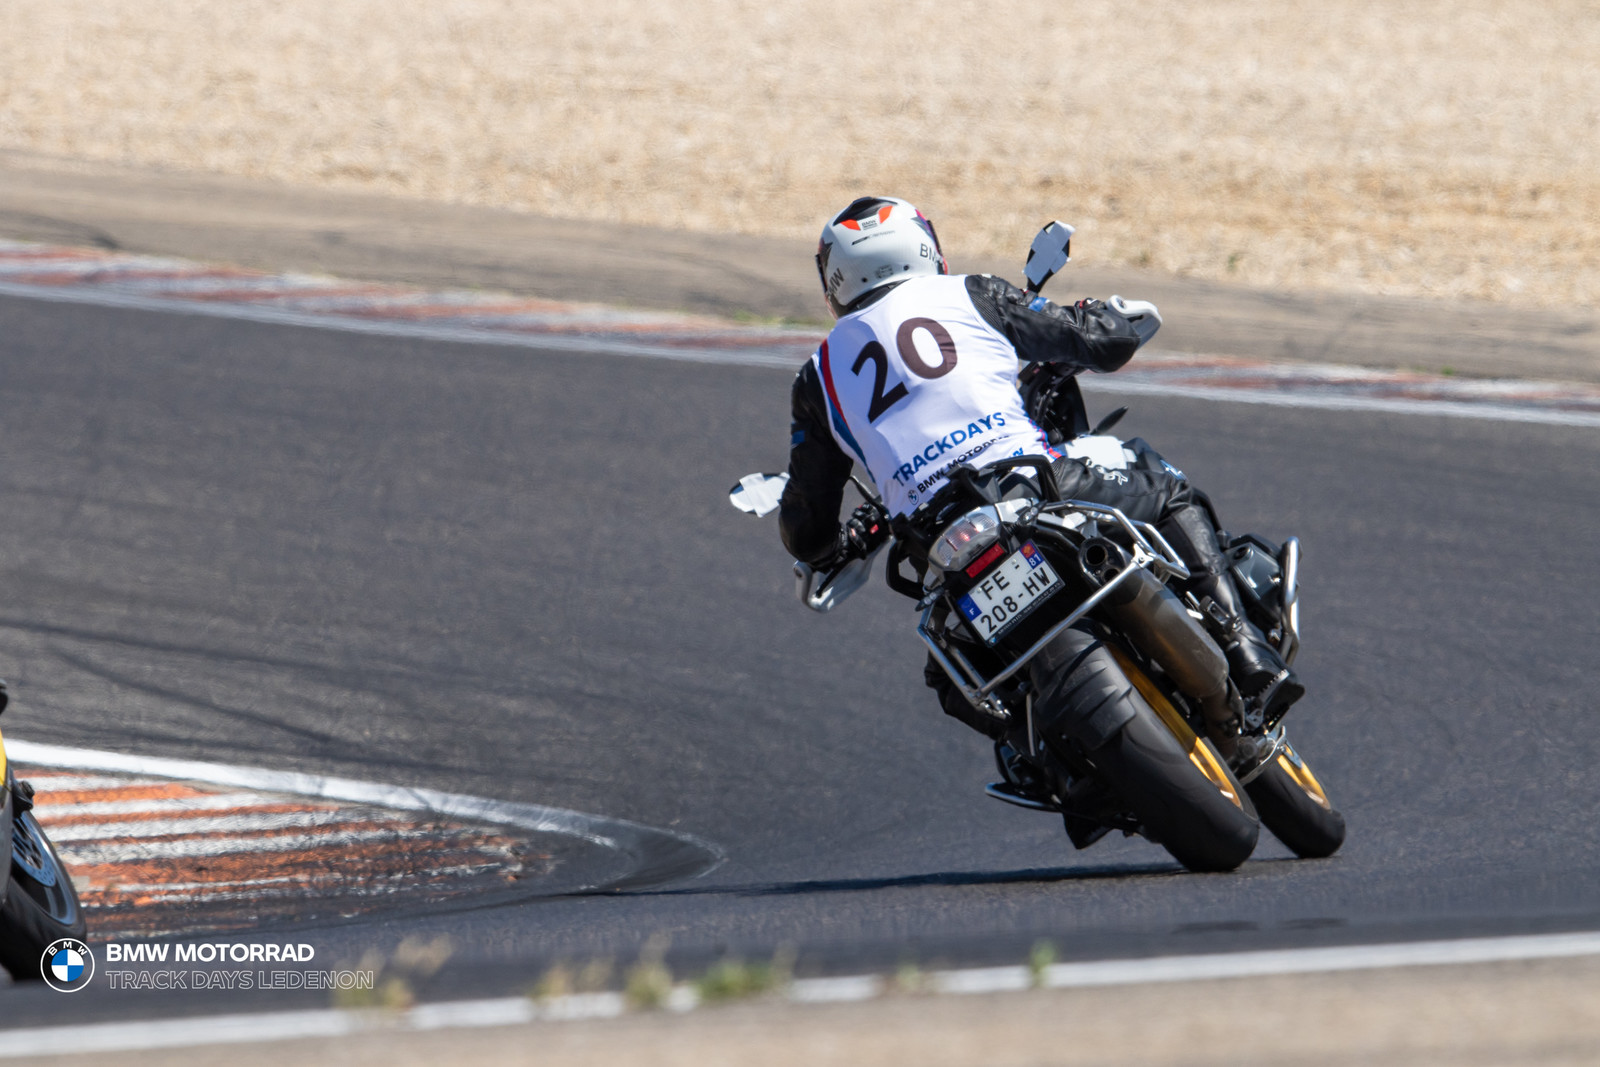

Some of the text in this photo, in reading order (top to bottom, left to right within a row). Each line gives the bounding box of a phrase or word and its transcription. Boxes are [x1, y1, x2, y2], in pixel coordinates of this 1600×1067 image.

[919, 242, 937, 262] BM
[851, 316, 959, 424] 20
[892, 411, 1006, 487] TRACKDAYS
[916, 467, 948, 494] BMW
[1028, 553, 1042, 567] 81
[969, 607, 975, 616] F
[980, 567, 1051, 633] 208-HW
